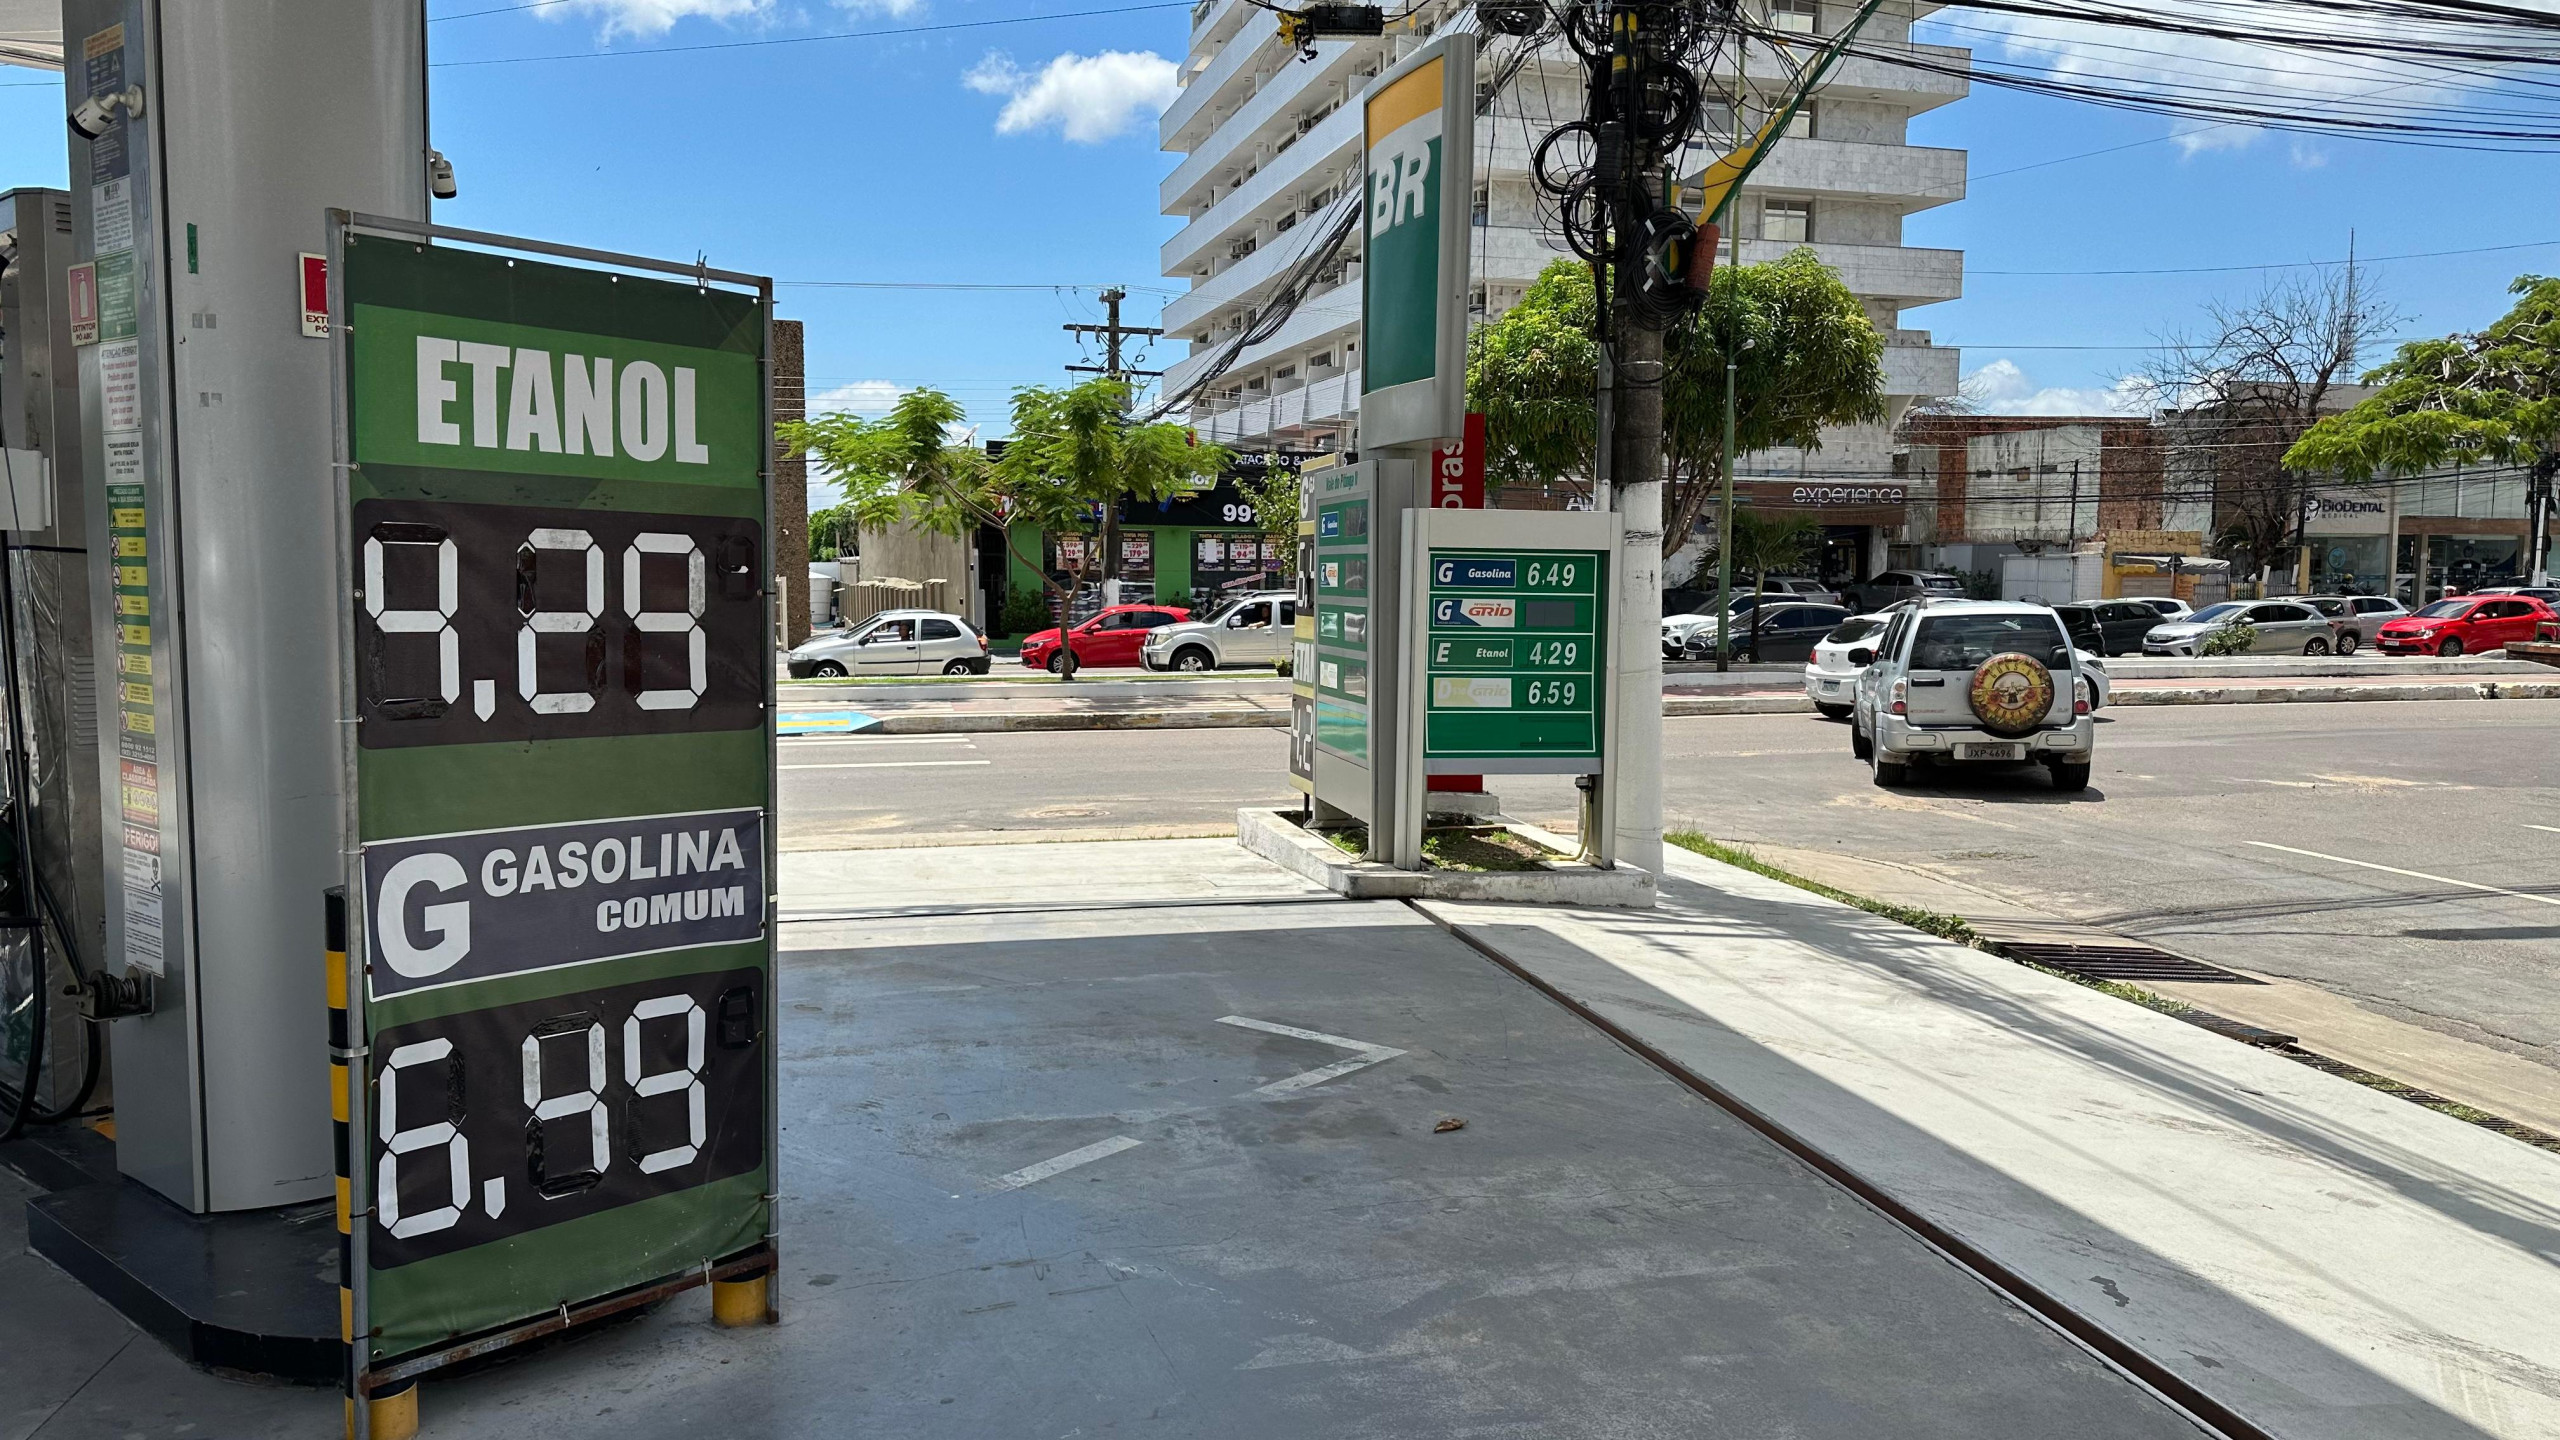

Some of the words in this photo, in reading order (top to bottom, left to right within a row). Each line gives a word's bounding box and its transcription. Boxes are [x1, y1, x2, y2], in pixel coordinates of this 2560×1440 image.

[1370, 140, 1431, 239] BR
[72, 324, 96, 333] EXTINTOR
[416, 334, 709, 464] ETANOL
[1793, 487, 1902, 507] experience
[1438, 562, 1454, 583] G
[1468, 568, 1511, 579] Gasolina
[1527, 562, 1575, 587] 6,49
[364, 528, 706, 722] 4,29
[1437, 600, 1452, 620] G
[1436, 642, 1451, 663] E
[1476, 648, 1508, 658] Etanol
[1530, 642, 1576, 665] 4,29
[1528, 681, 1576, 706] 6,59
[125, 828, 159, 851] PERIGO!
[481, 827, 745, 897] GASOLINA
[377, 852, 470, 979] G
[597, 886, 745, 933] COMUM
[378, 993, 706, 1239] 6,49
